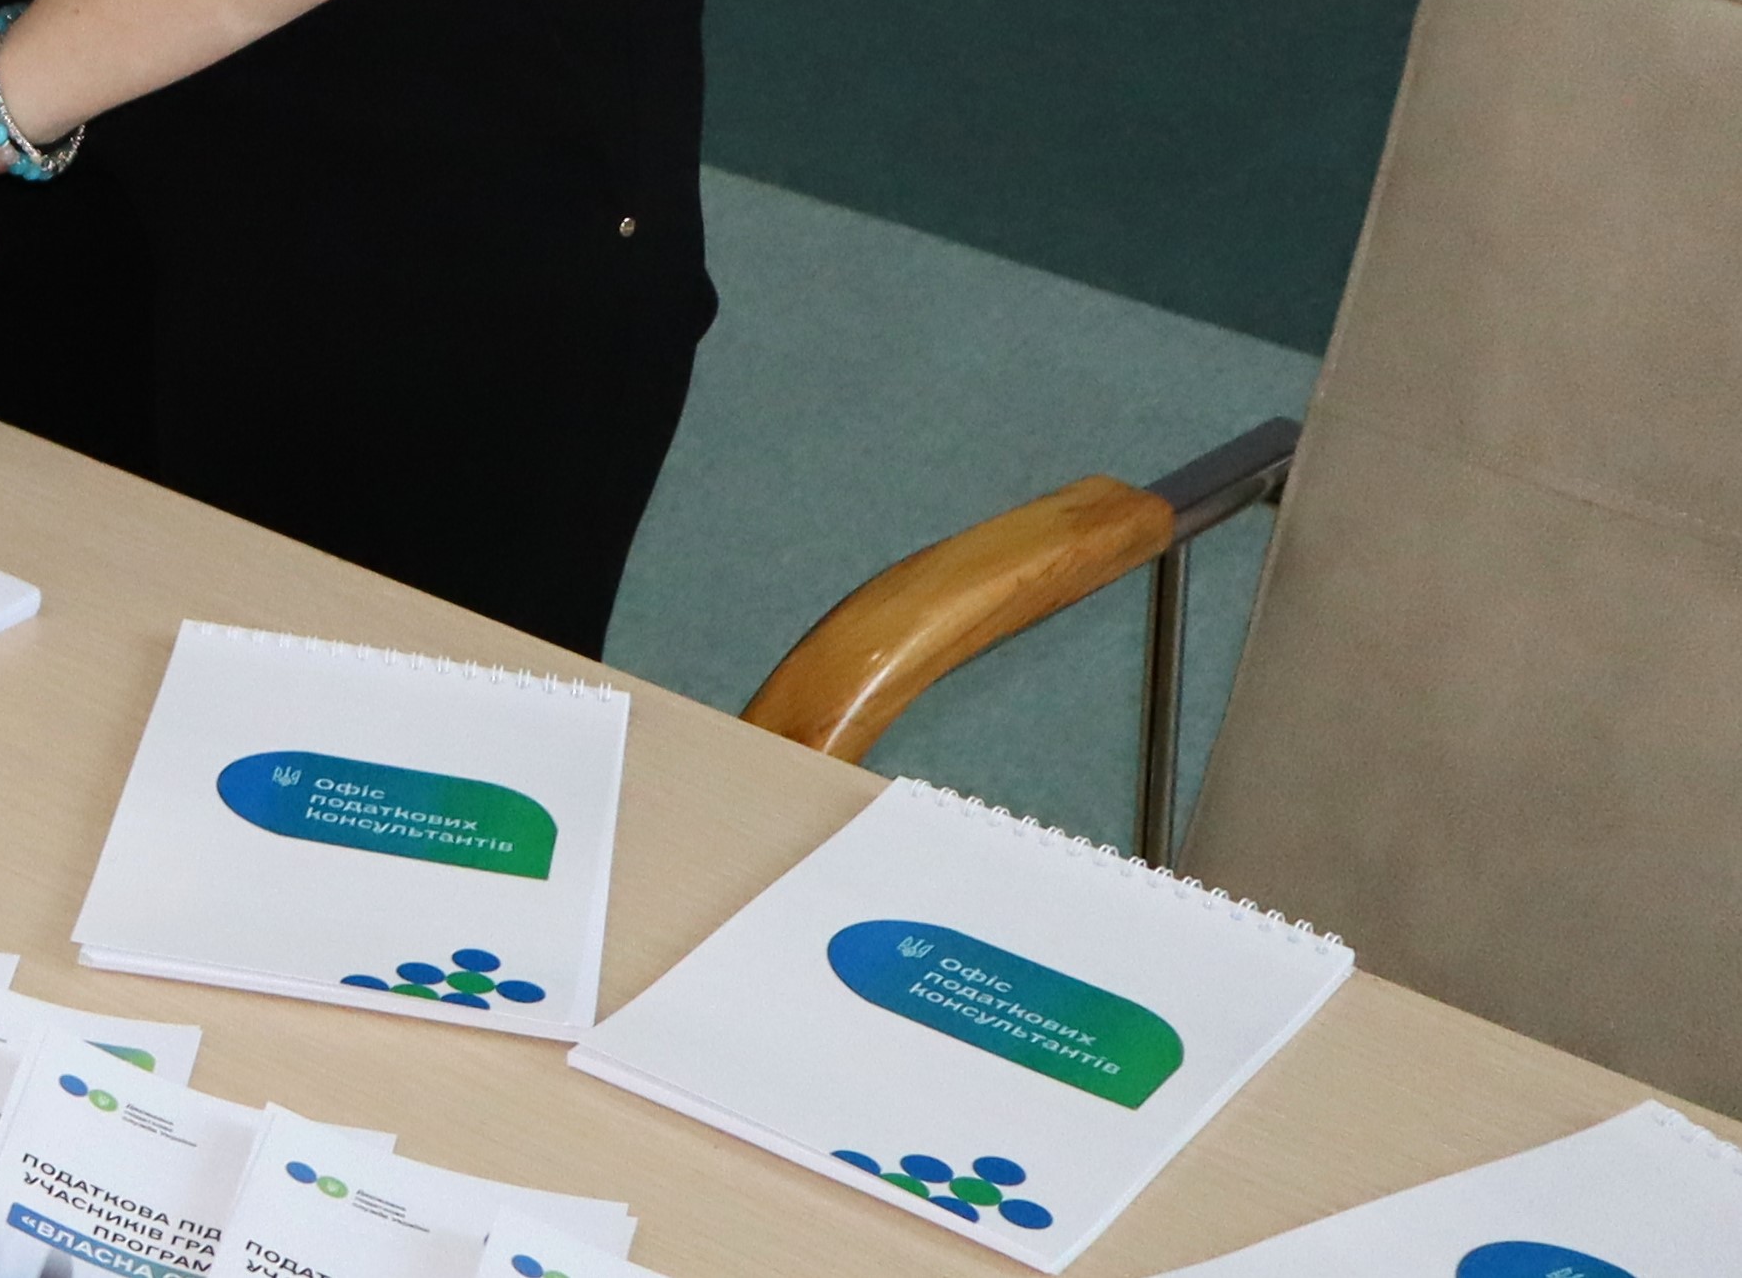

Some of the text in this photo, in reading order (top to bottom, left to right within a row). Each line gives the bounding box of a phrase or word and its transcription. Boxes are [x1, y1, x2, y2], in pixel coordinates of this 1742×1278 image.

[309, 794, 479, 831] податкових
[314, 778, 386, 799] Офіс
[305, 807, 515, 853] консультантів
[940, 957, 1013, 993] Офіс
[909, 982, 1121, 1075] консультантів
[923, 971, 1097, 1047] податкових
[22, 1152, 170, 1226] ПОДАТКОВА
[23, 1172, 164, 1241] УЧАСНИКІВ
